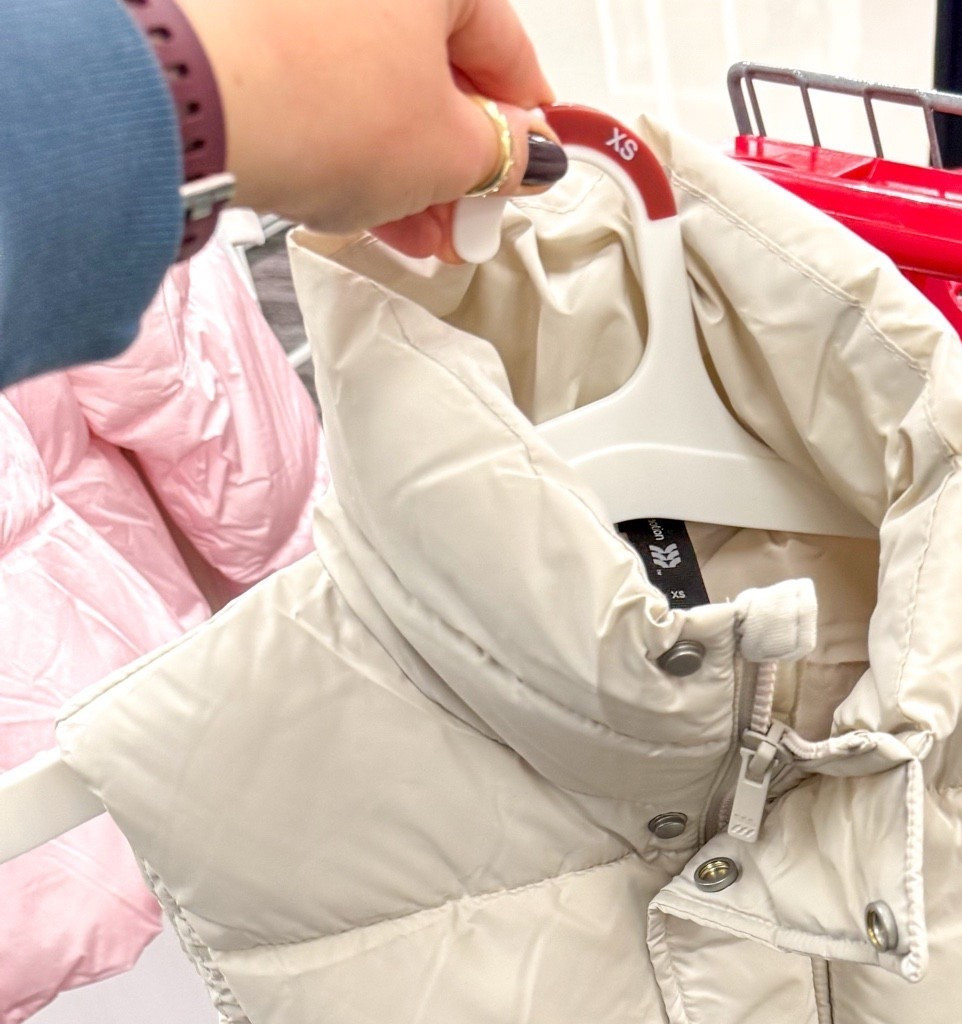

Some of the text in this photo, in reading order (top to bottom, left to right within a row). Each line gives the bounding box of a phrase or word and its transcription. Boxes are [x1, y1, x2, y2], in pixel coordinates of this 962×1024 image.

[605, 126, 639, 161] XS
[648, 519, 665, 541] otion
[670, 590, 686, 599] XS
